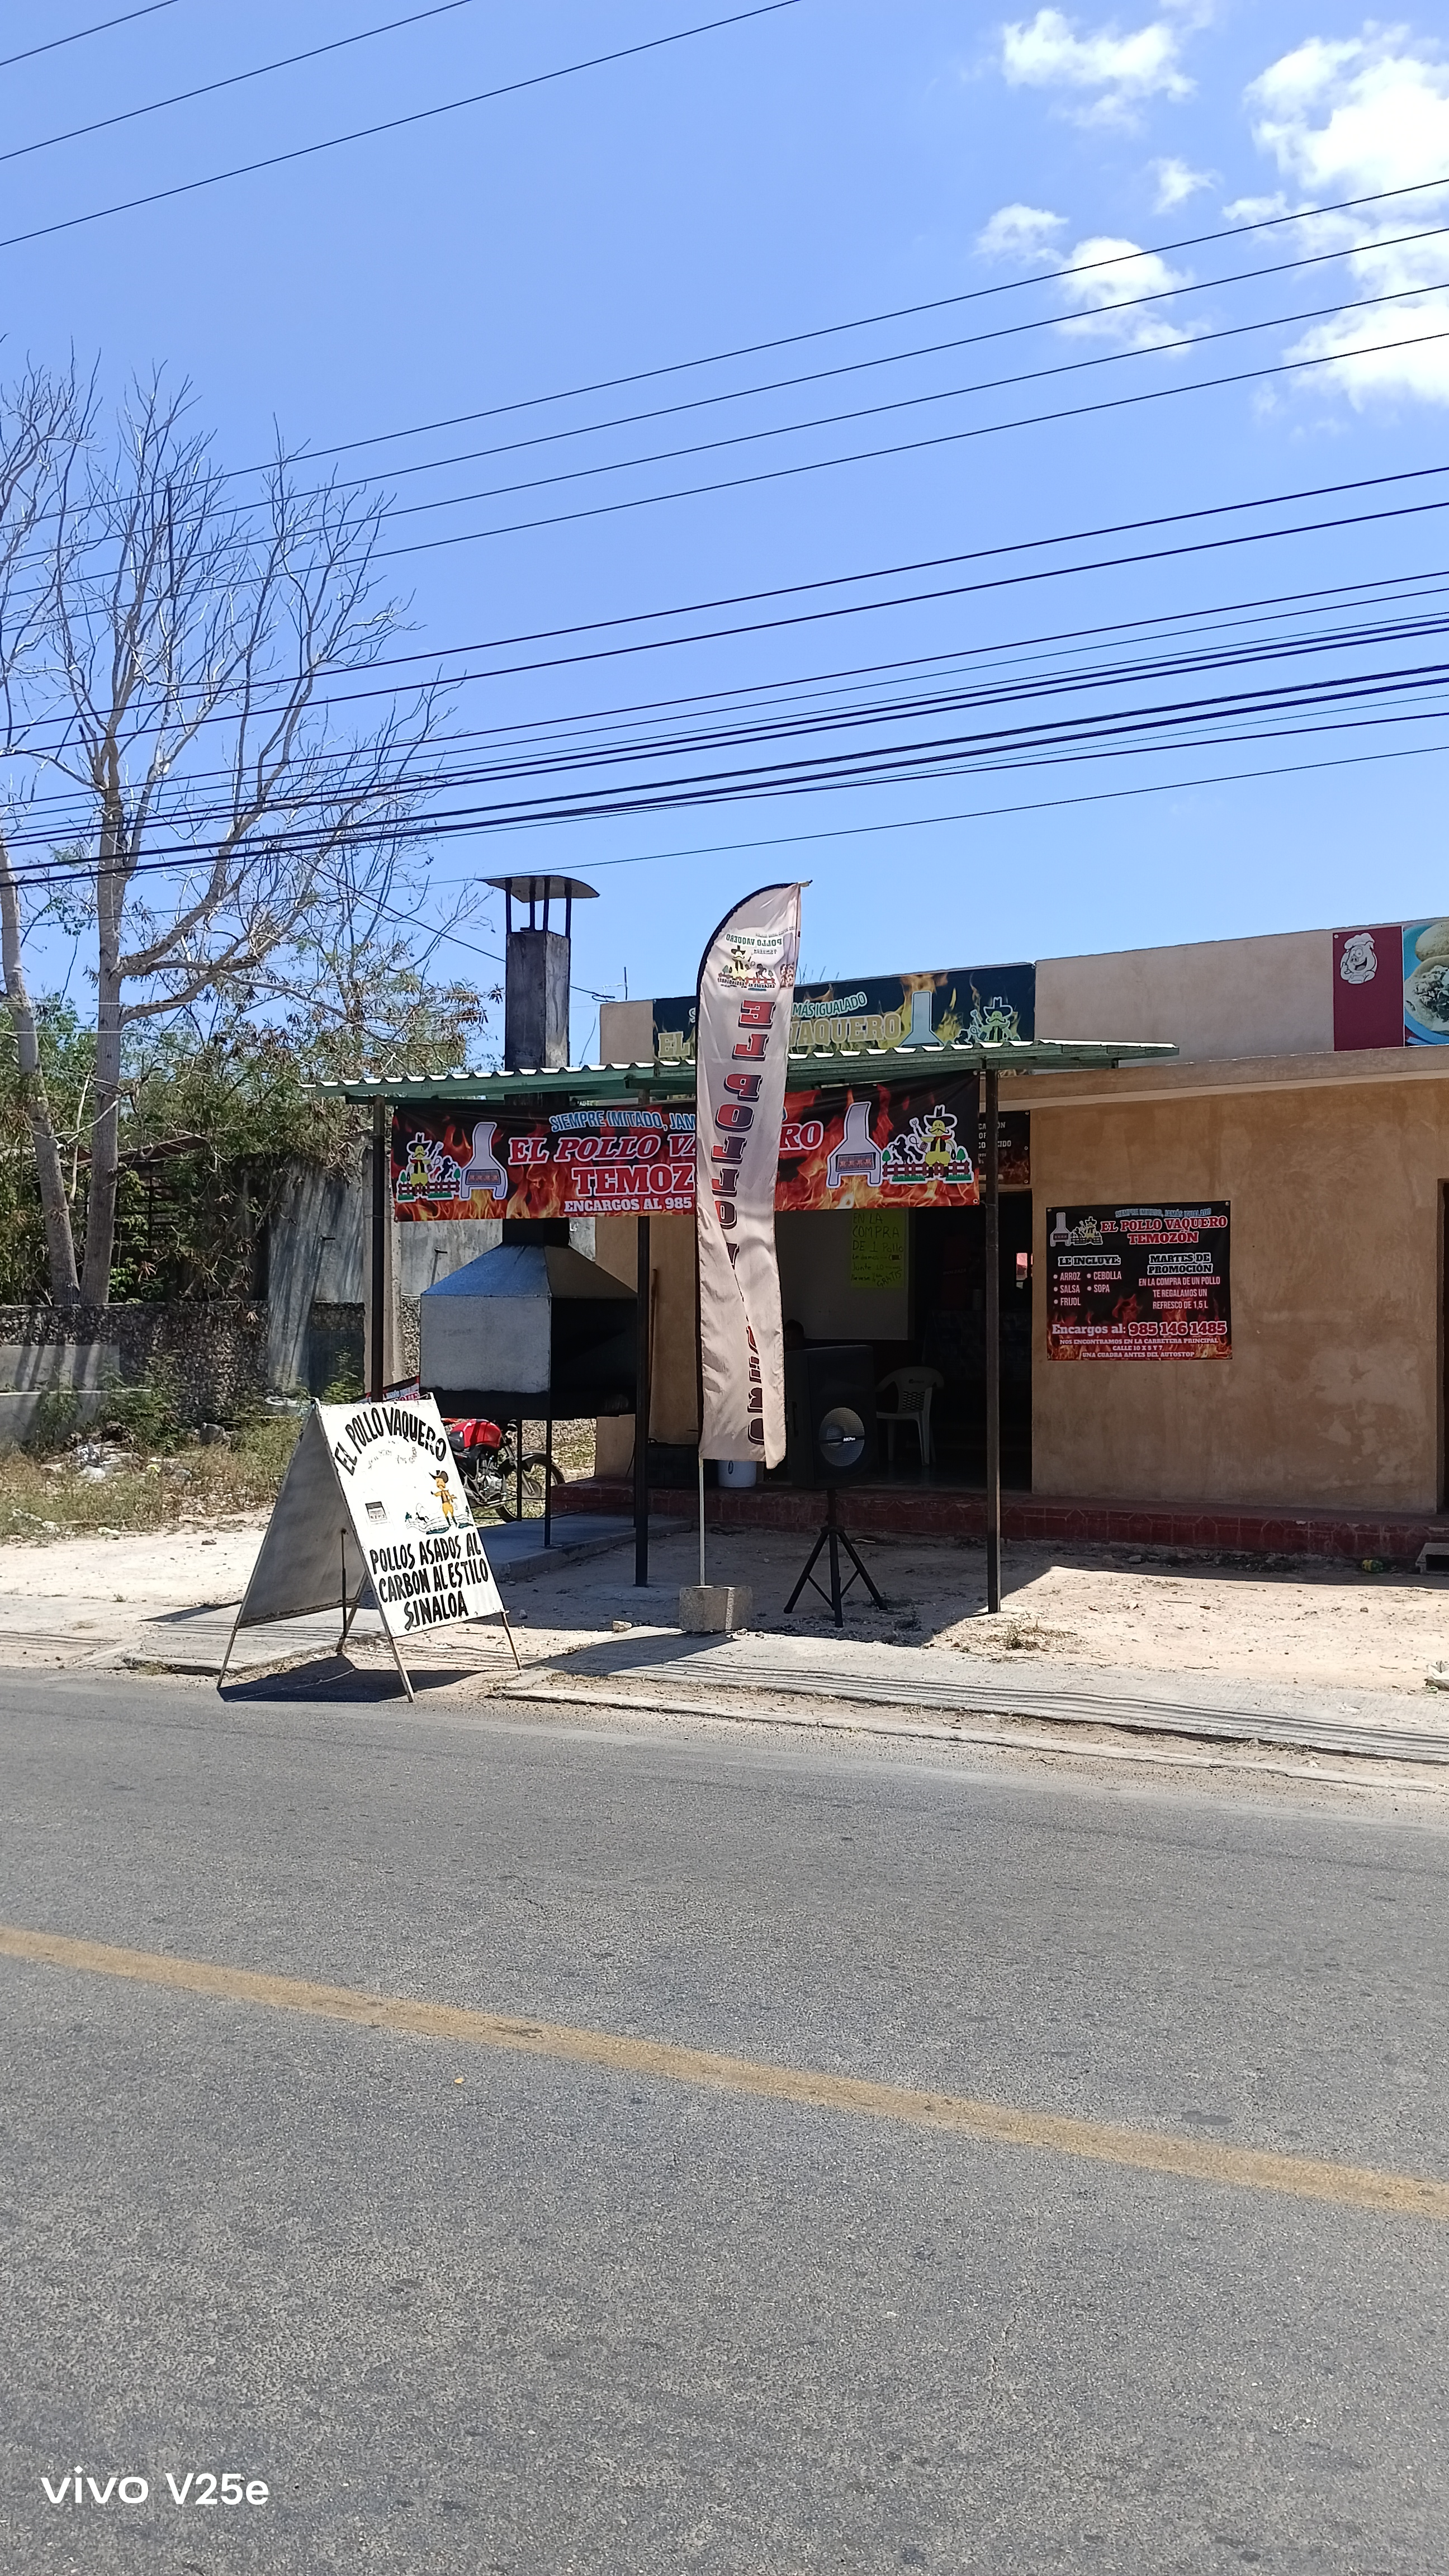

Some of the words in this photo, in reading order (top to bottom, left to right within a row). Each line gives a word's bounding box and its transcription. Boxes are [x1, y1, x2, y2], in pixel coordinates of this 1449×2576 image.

[792, 999, 815, 1017] MÁS
[814, 991, 868, 1017] IGUALADO
[658, 1031, 690, 1058] EL
[549, 1111, 606, 1132] SIEMPRE
[607, 1111, 668, 1130] IMITADO,
[670, 1113, 695, 1130] JAM
[508, 1138, 549, 1165] EL
[553, 1135, 661, 1162] POLLO
[572, 1163, 695, 1197] TEMOZ
[564, 1199, 641, 1212] ENCARGOS
[643, 1198, 664, 1210] AL
[665, 1197, 692, 1209] 985
[853, 1213, 865, 1224] EN
[869, 1213, 883, 1224] LA
[1100, 1221, 1119, 1233] EL
[1120, 1218, 1162, 1232] POLLO
[1163, 1215, 1228, 1232] VAQUERO
[853, 1225, 899, 1239] COMPRA
[1127, 1231, 1199, 1245] TEMOZÓN
[853, 1240, 865, 1251] DE
[869, 1241, 878, 1252] 1
[1058, 1256, 1072, 1266] LE
[1149, 1253, 1194, 1264] MARTES
[1195, 1253, 1211, 1262] DE
[1060, 1272, 1081, 1281] ARROZ
[1093, 1271, 1122, 1280] CEBOLLA
[1147, 1263, 1213, 1275] PROMOCIÓN
[1156, 1277, 1181, 1286] COMPRA
[1191, 1277, 1201, 1285] UN
[1201, 1276, 1220, 1285] POLLO
[1060, 1285, 1080, 1294] SALSA
[1094, 1285, 1110, 1293] SOPA
[1162, 1289, 1197, 1298] REGALAMOS
[1199, 1289, 1208, 1297] UN
[1060, 1298, 1081, 1306] FRIJOL
[1153, 1301, 1182, 1309] REFRESCO
[1194, 1300, 1203, 1310] 1,5
[1204, 1300, 1208, 1309] L
[1052, 1324, 1108, 1336] Encargos
[1111, 1323, 1126, 1334] al:
[1128, 1322, 1158, 1336] 985
[1159, 1322, 1188, 1336] 146
[1189, 1321, 1227, 1335] 1485
[345, 1407, 384, 1455] POLLO
[382, 1407, 447, 1462] VAQUERO
[335, 1441, 358, 1476] EL
[370, 1543, 415, 1575] POLLOS
[419, 1535, 461, 1566] ASADOS
[466, 1532, 481, 1557] AL
[379, 1568, 430, 1603] CARBON
[433, 1564, 448, 1592] AL
[448, 1558, 489, 1588] ESTILO
[404, 1590, 468, 1631] SINALOA
